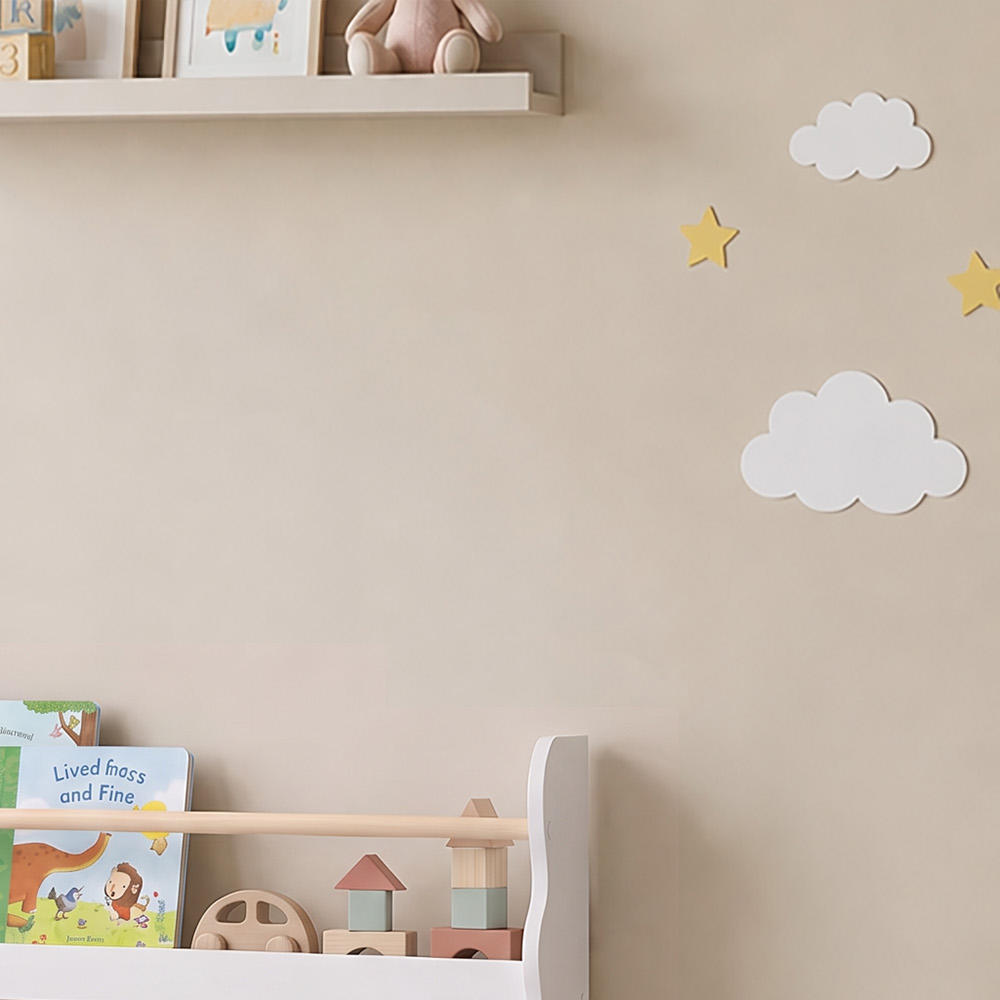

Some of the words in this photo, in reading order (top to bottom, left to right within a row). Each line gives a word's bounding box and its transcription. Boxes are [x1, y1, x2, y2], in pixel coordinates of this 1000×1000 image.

[53, 757, 101, 782] Lived
[60, 782, 93, 804] and
[99, 784, 135, 805] Fine
